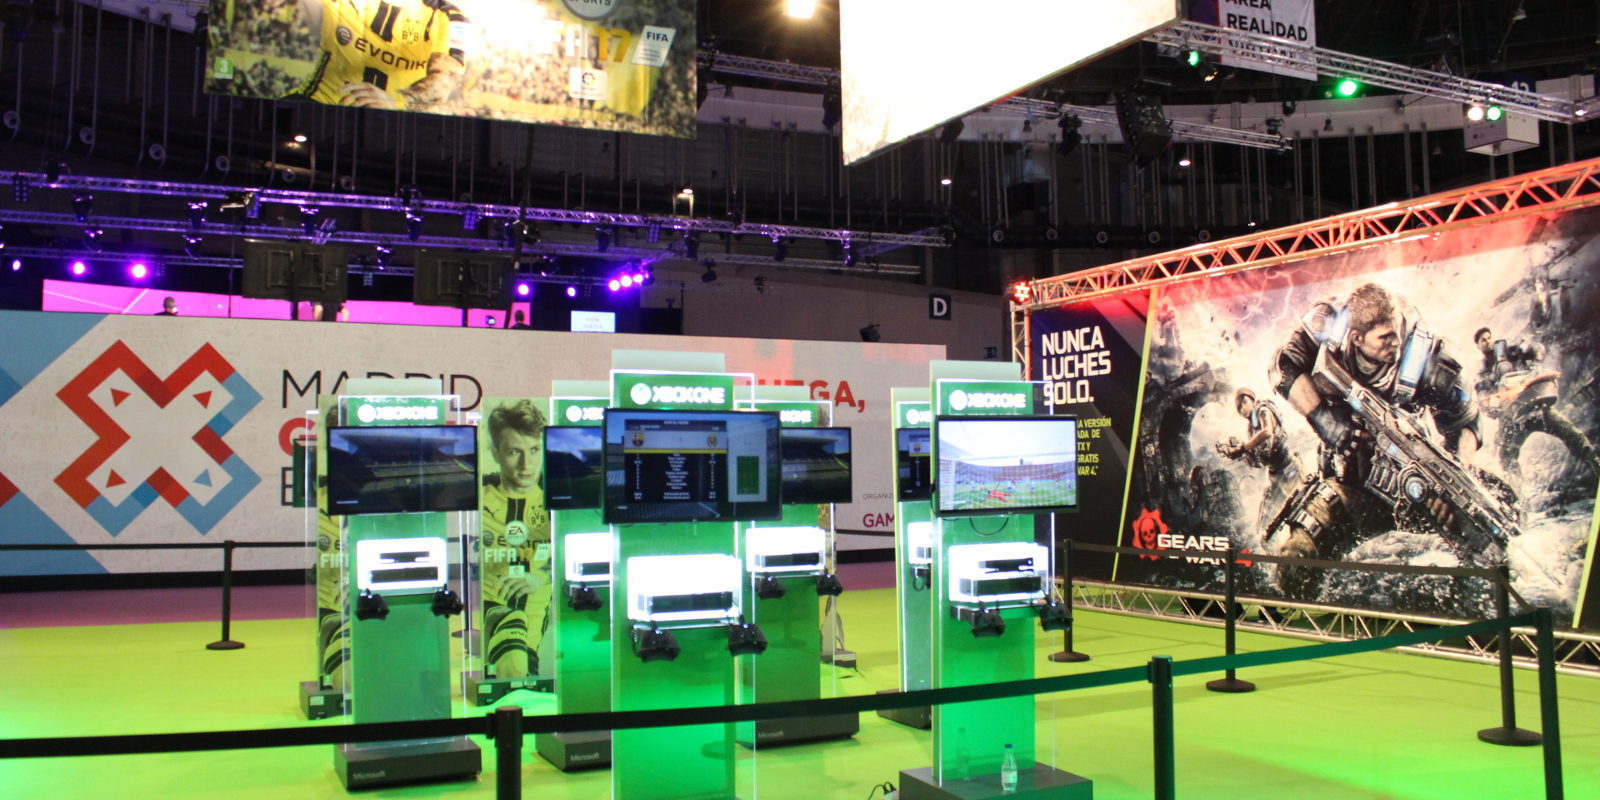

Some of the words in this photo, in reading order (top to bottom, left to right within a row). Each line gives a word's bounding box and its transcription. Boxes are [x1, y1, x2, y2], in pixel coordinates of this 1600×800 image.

[1226, 13, 1308, 41] REALIDAD
[595, 25, 631, 63] 17
[646, 31, 669, 42] FIFA
[354, 37, 426, 71] EVONIK
[220, 60, 228, 73] 3
[932, 297, 948, 317] D
[1042, 325, 1104, 356] NUNCA
[1042, 350, 1111, 381] LUCHES
[652, 386, 692, 403] XBOX
[692, 386, 725, 404] ONE
[745, 378, 865, 413] GA,
[967, 392, 1000, 407] XBOX
[1000, 393, 1026, 408] ONE
[1043, 379, 1094, 406] SOLO.
[375, 405, 411, 421] XBOX
[410, 405, 438, 421] ONE
[1084, 416, 1112, 428] VERSIÓN
[1091, 429, 1101, 438] DE
[1086, 442, 1091, 451] Y
[508, 526, 525, 535] EA
[1157, 533, 1230, 551] GEARS
[320, 552, 349, 568] FIF
[484, 548, 518, 563] FIFA
[570, 752, 600, 762] Microsoft
[352, 769, 387, 781] Microsoft
